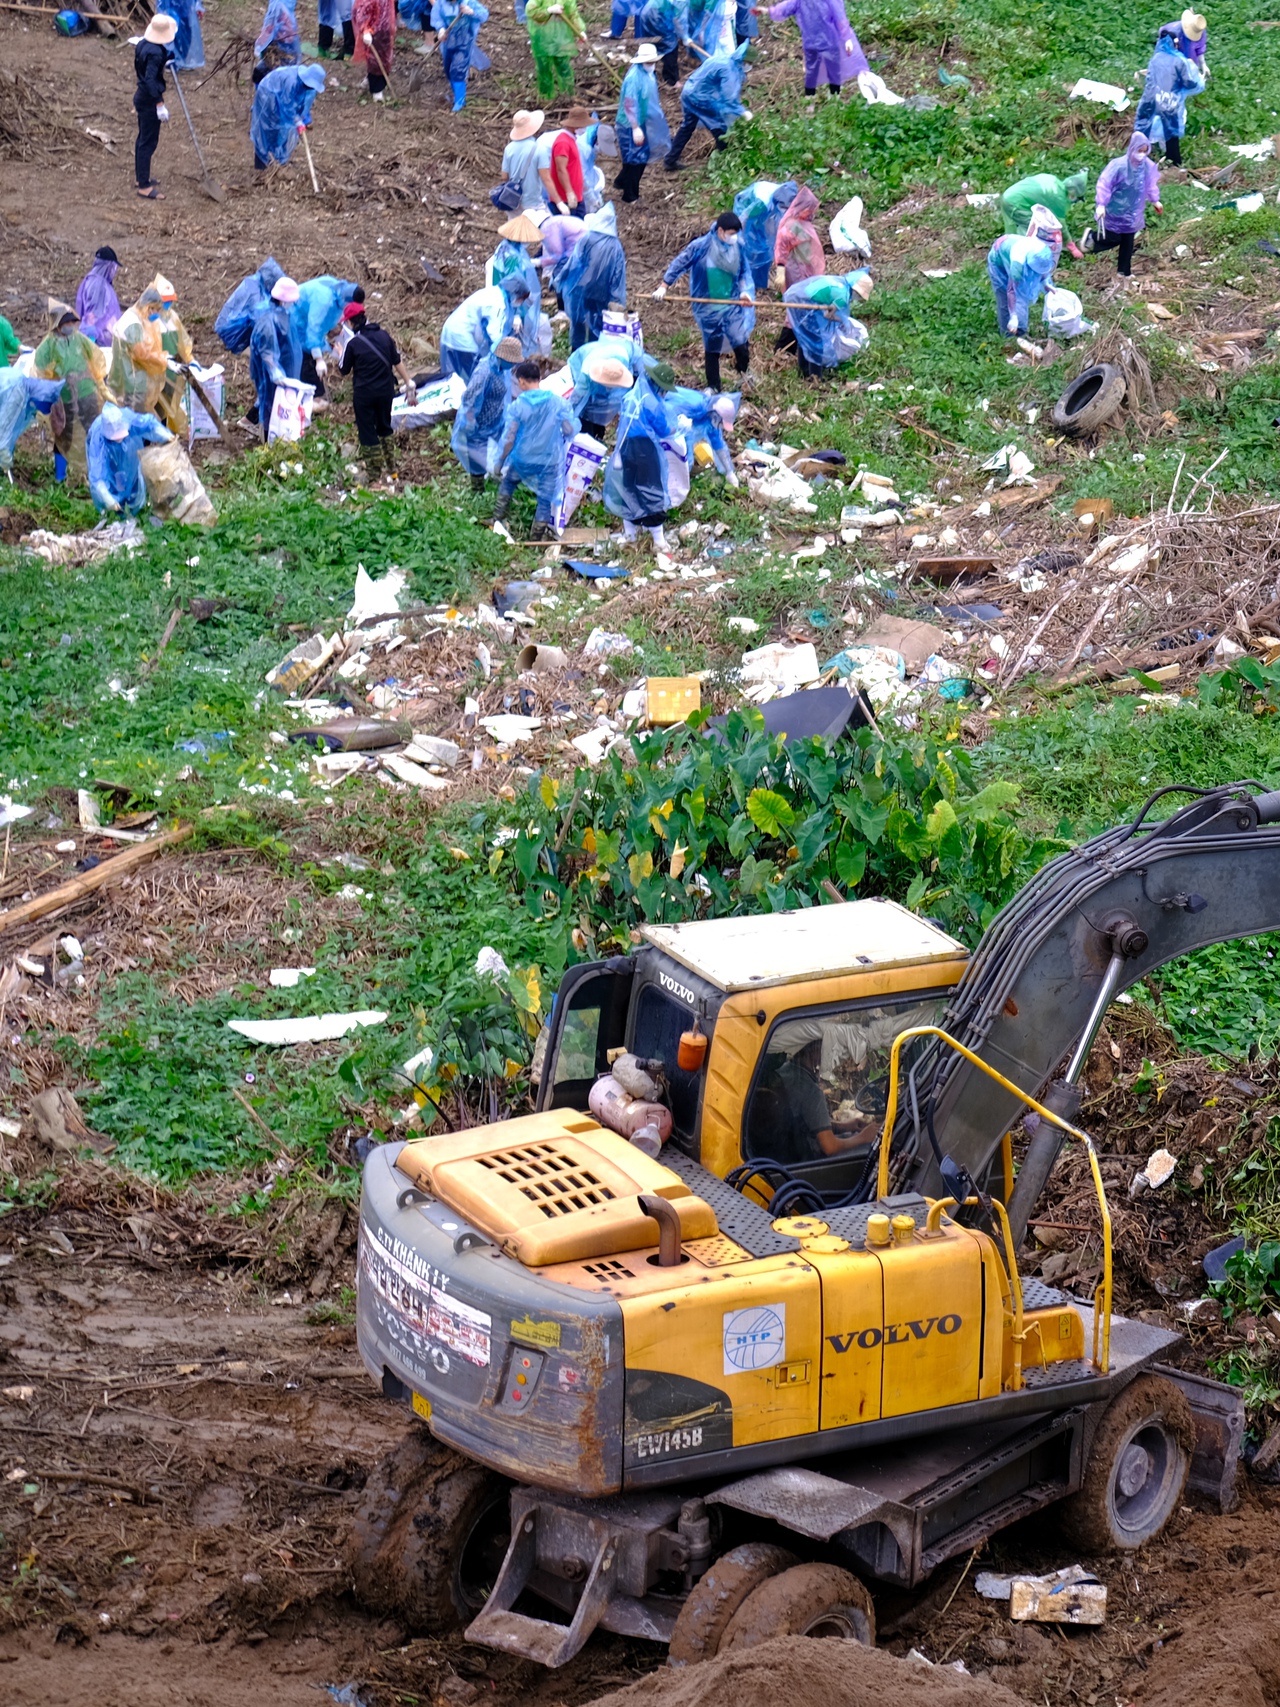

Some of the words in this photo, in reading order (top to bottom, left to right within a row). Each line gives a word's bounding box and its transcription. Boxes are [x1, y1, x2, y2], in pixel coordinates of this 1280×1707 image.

[658, 971, 695, 1005] VOLVO
[737, 1332, 770, 1345] HTP
[825, 1313, 962, 1354] VOLVO
[637, 1426, 702, 1458] EW145B
